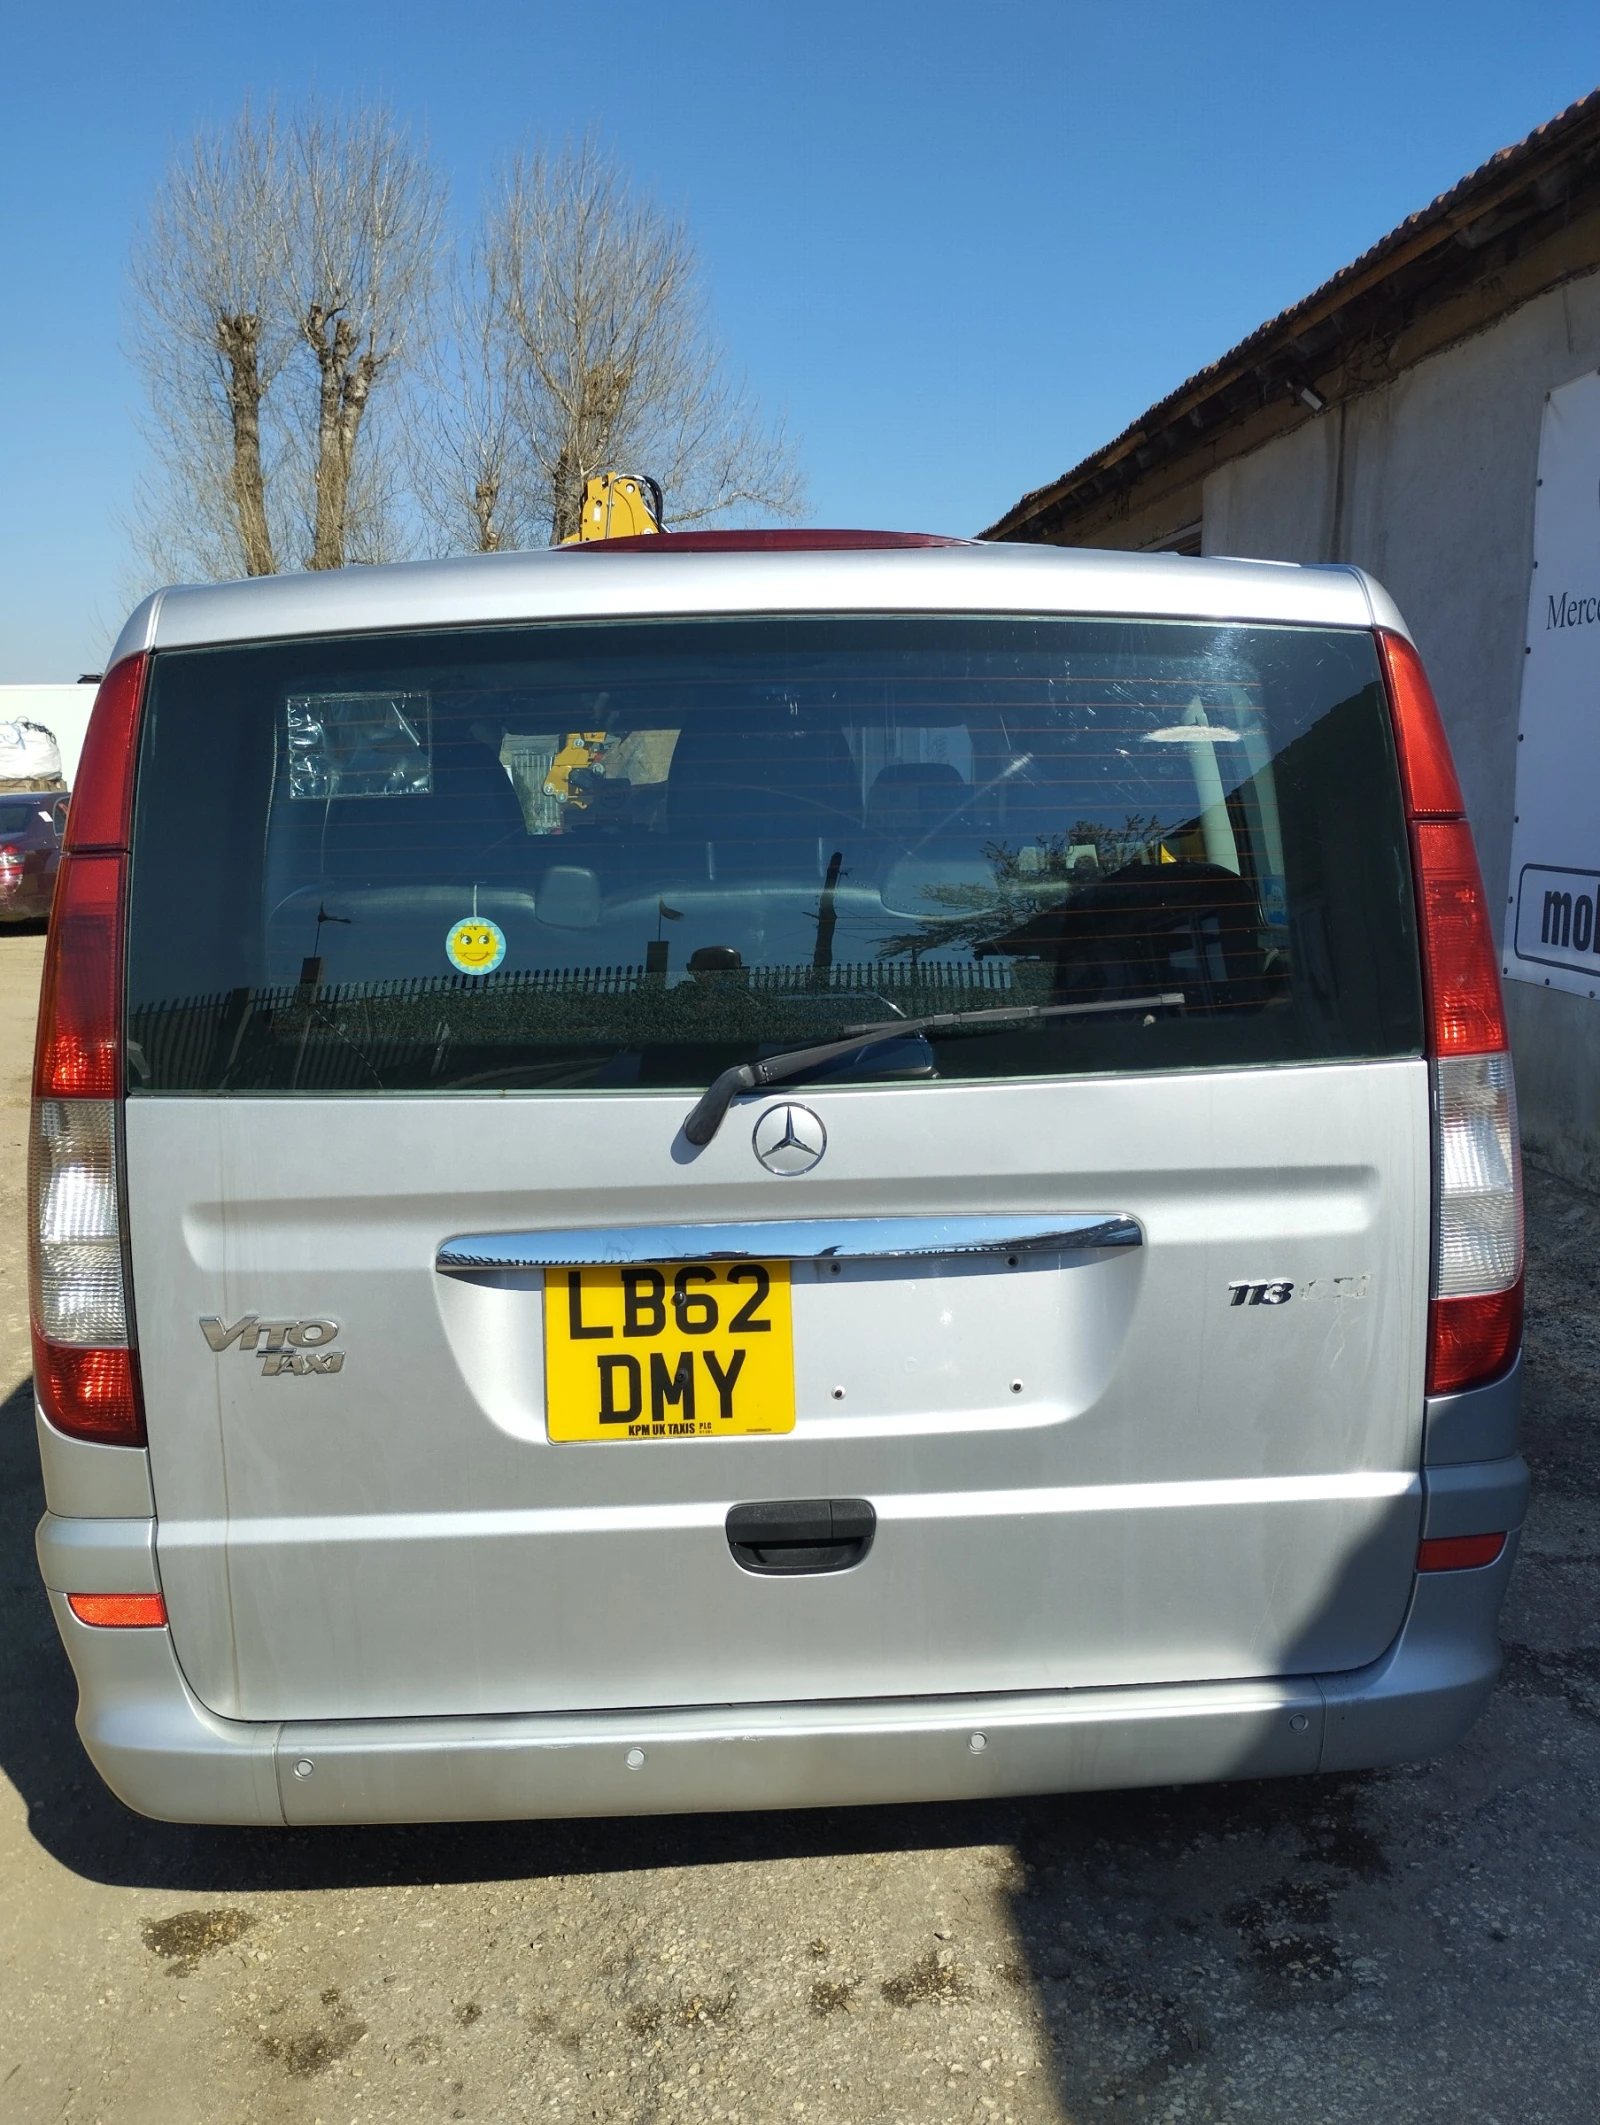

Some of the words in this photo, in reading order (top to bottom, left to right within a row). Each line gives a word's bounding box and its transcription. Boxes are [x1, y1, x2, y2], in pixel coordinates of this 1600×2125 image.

[1545, 592, 1600, 630] Merc
[568, 1264, 771, 1340] LB62
[1228, 1277, 1294, 1306] 113
[199, 1314, 339, 1352] VITO
[256, 1348, 345, 1376] TAXI
[597, 1349, 746, 1424] DMY
[628, 1424, 650, 1436] KPM
[652, 1423, 666, 1436] UK
[668, 1422, 695, 1435] TAXIS
